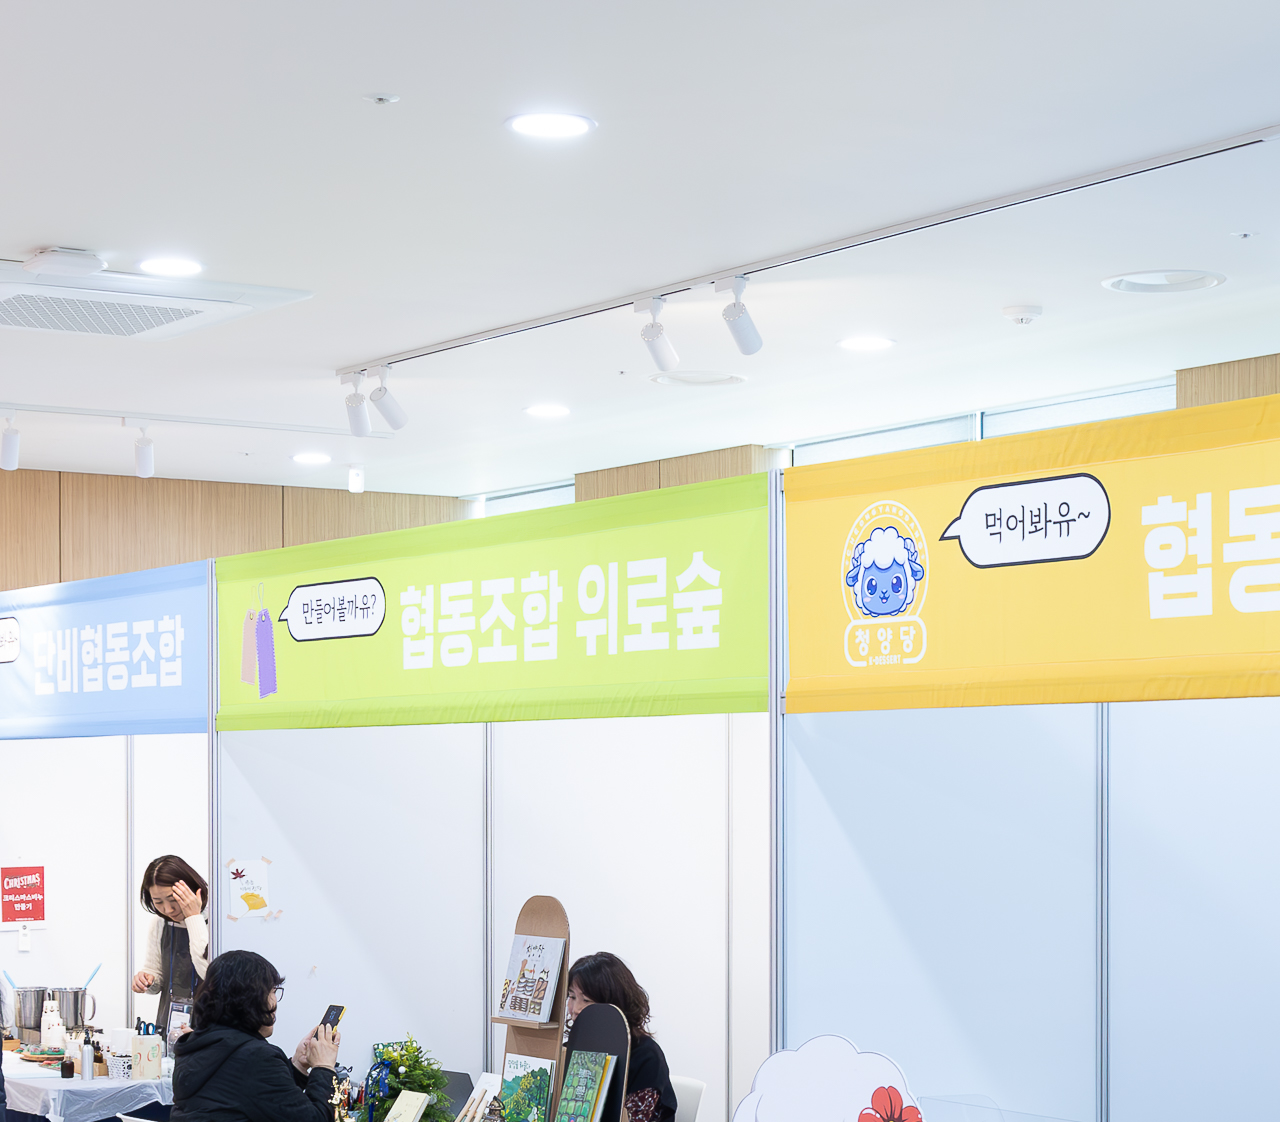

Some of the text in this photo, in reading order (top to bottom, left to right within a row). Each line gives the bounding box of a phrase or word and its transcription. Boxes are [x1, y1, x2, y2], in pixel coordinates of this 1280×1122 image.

[984, 501, 1091, 544] 먹어봐유~
[301, 593, 378, 626] 만들어볼까유?
[400, 550, 724, 671] 협동조합 위로숲
[32, 614, 185, 696] 단비협동조합
[854, 625, 916, 657] 청양당
[3, 872, 41, 890] CHRISTMAS
